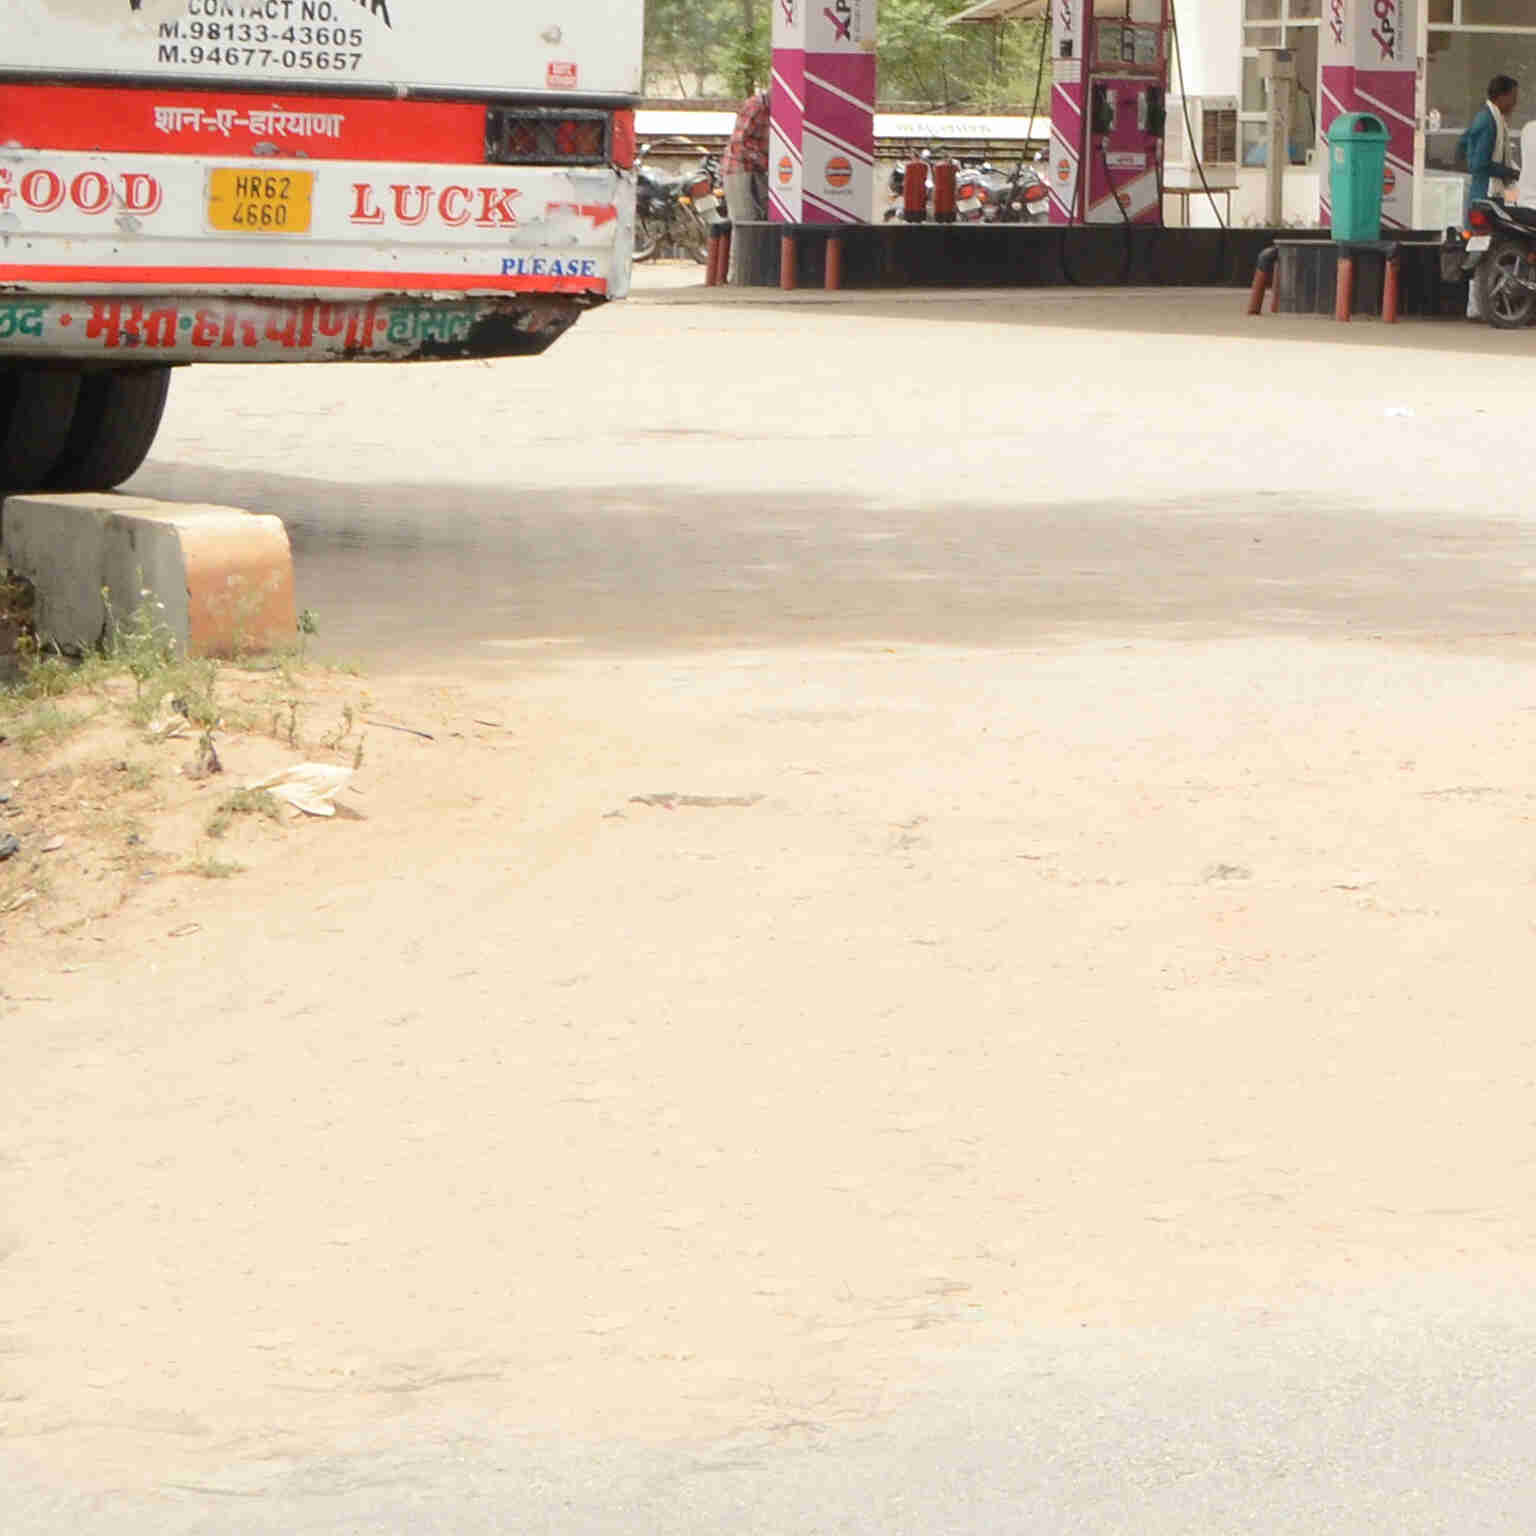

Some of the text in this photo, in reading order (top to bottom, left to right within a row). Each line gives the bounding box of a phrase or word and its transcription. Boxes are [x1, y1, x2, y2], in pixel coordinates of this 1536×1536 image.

[301, 0, 338, 22] NO.
[158, 22, 363, 47] M.98133-43605
[157, 45, 363, 71] M.94677-05657
[235, 176, 291, 200] HR62
[350, 183, 522, 228] LUCK
[500, 258, 596, 277] PLEASE
